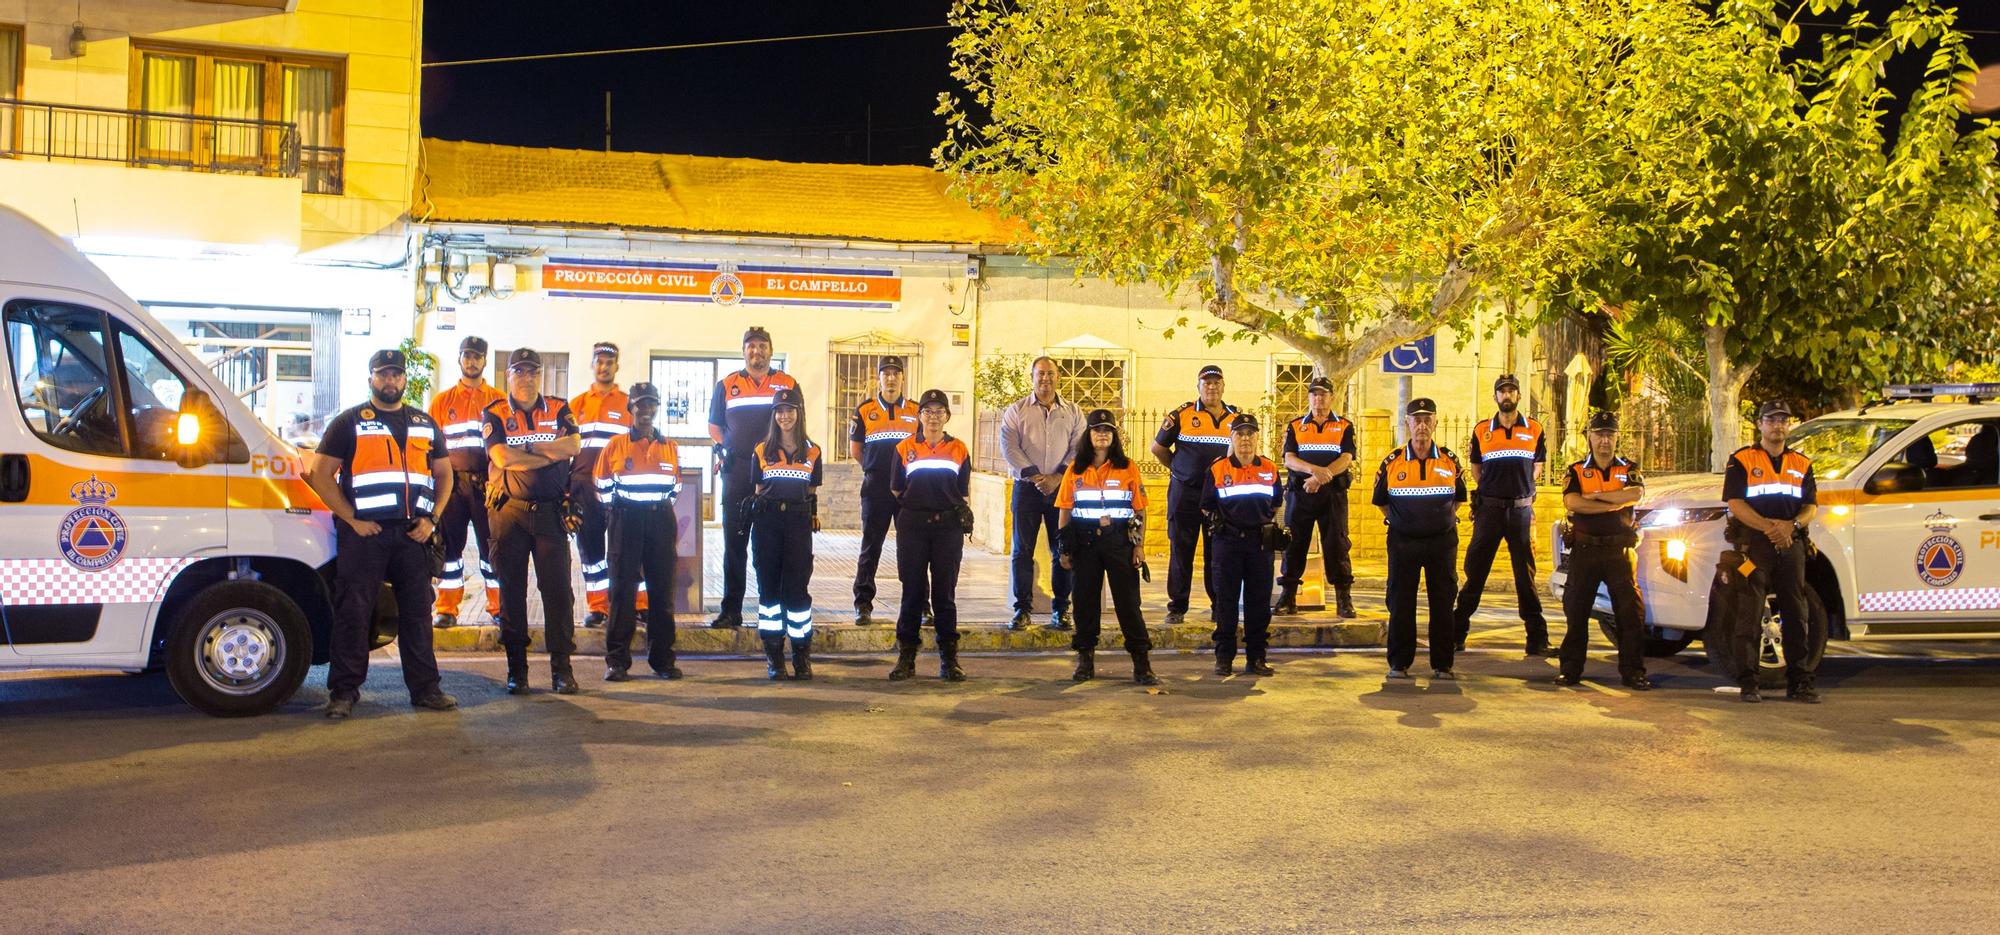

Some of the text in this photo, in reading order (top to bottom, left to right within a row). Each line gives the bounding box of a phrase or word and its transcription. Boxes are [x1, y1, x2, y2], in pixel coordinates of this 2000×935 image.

[555, 269, 697, 287] PROTECCIÓN CIVIL
[767, 279, 868, 293] EL CAMPELLO
